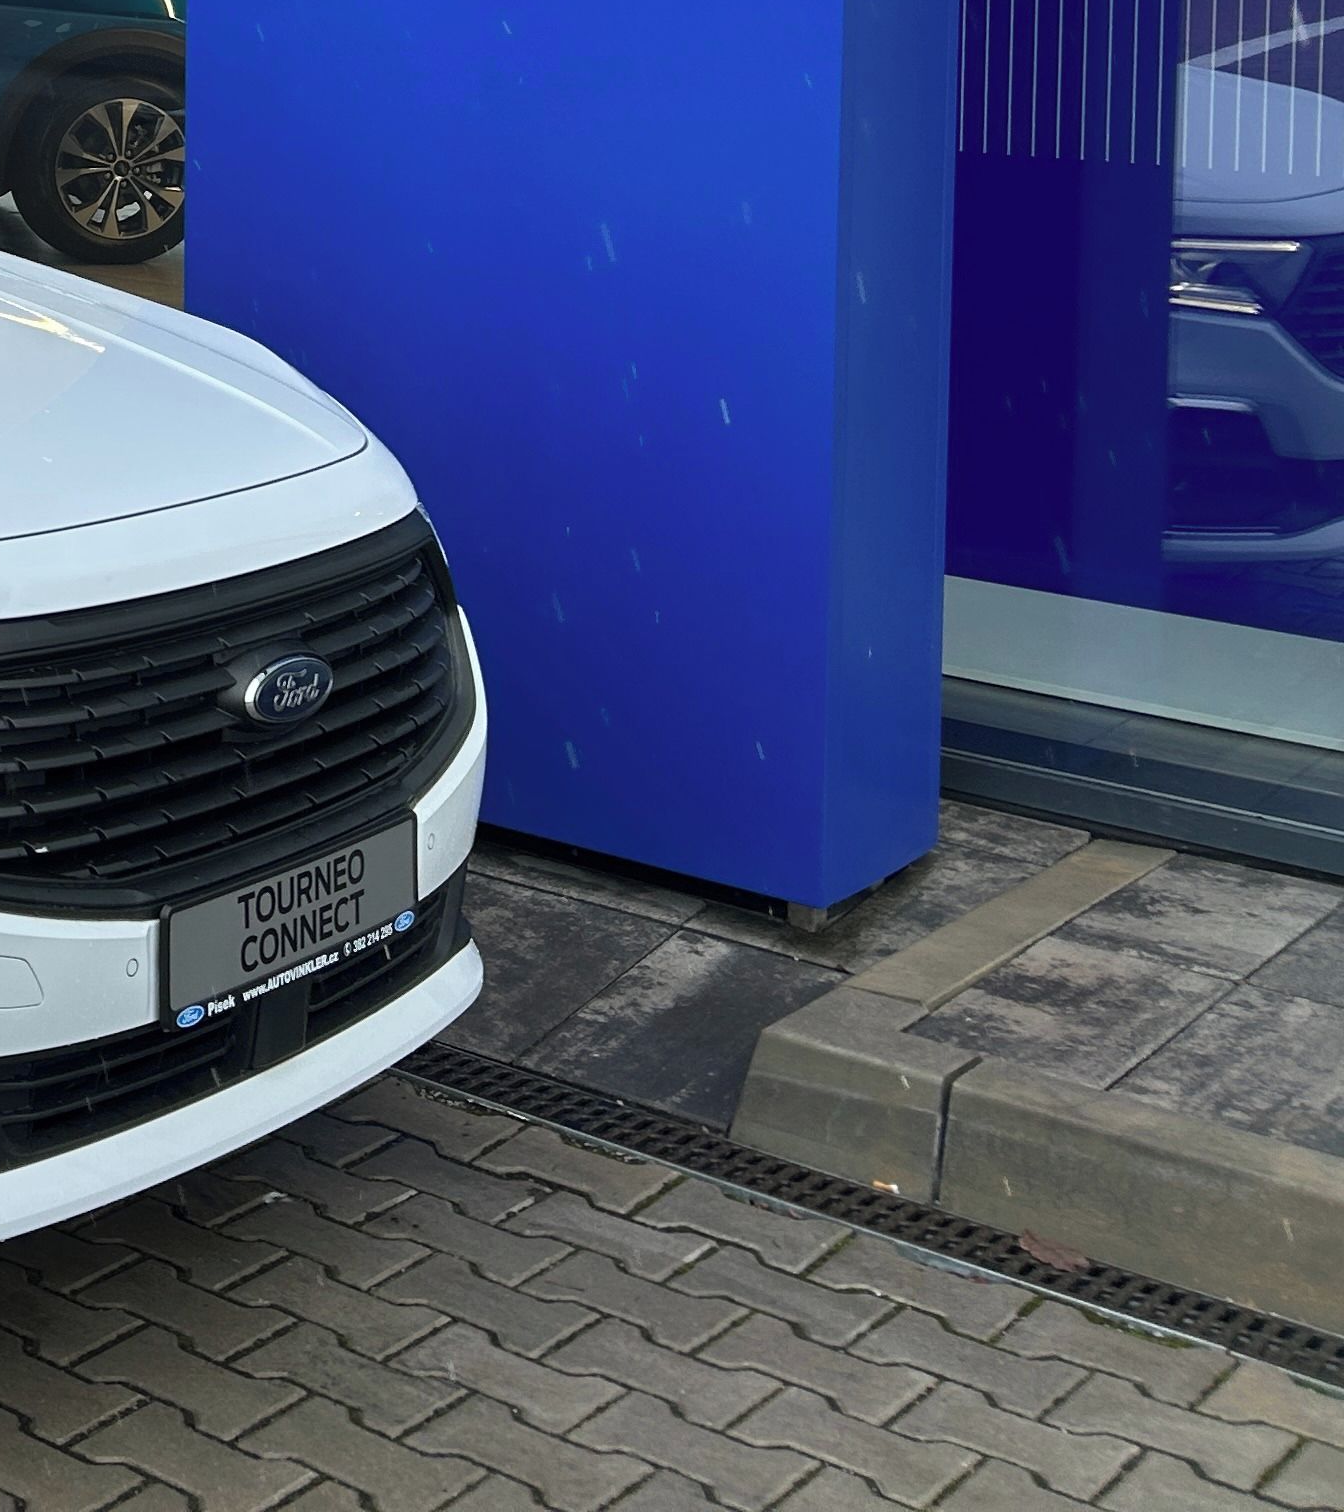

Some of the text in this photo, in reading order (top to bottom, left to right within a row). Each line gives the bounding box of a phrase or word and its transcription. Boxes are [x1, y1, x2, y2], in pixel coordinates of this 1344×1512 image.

[274, 668, 320, 712] Ford
[237, 849, 365, 929] TOURNEO
[241, 889, 365, 972] CONNECT
